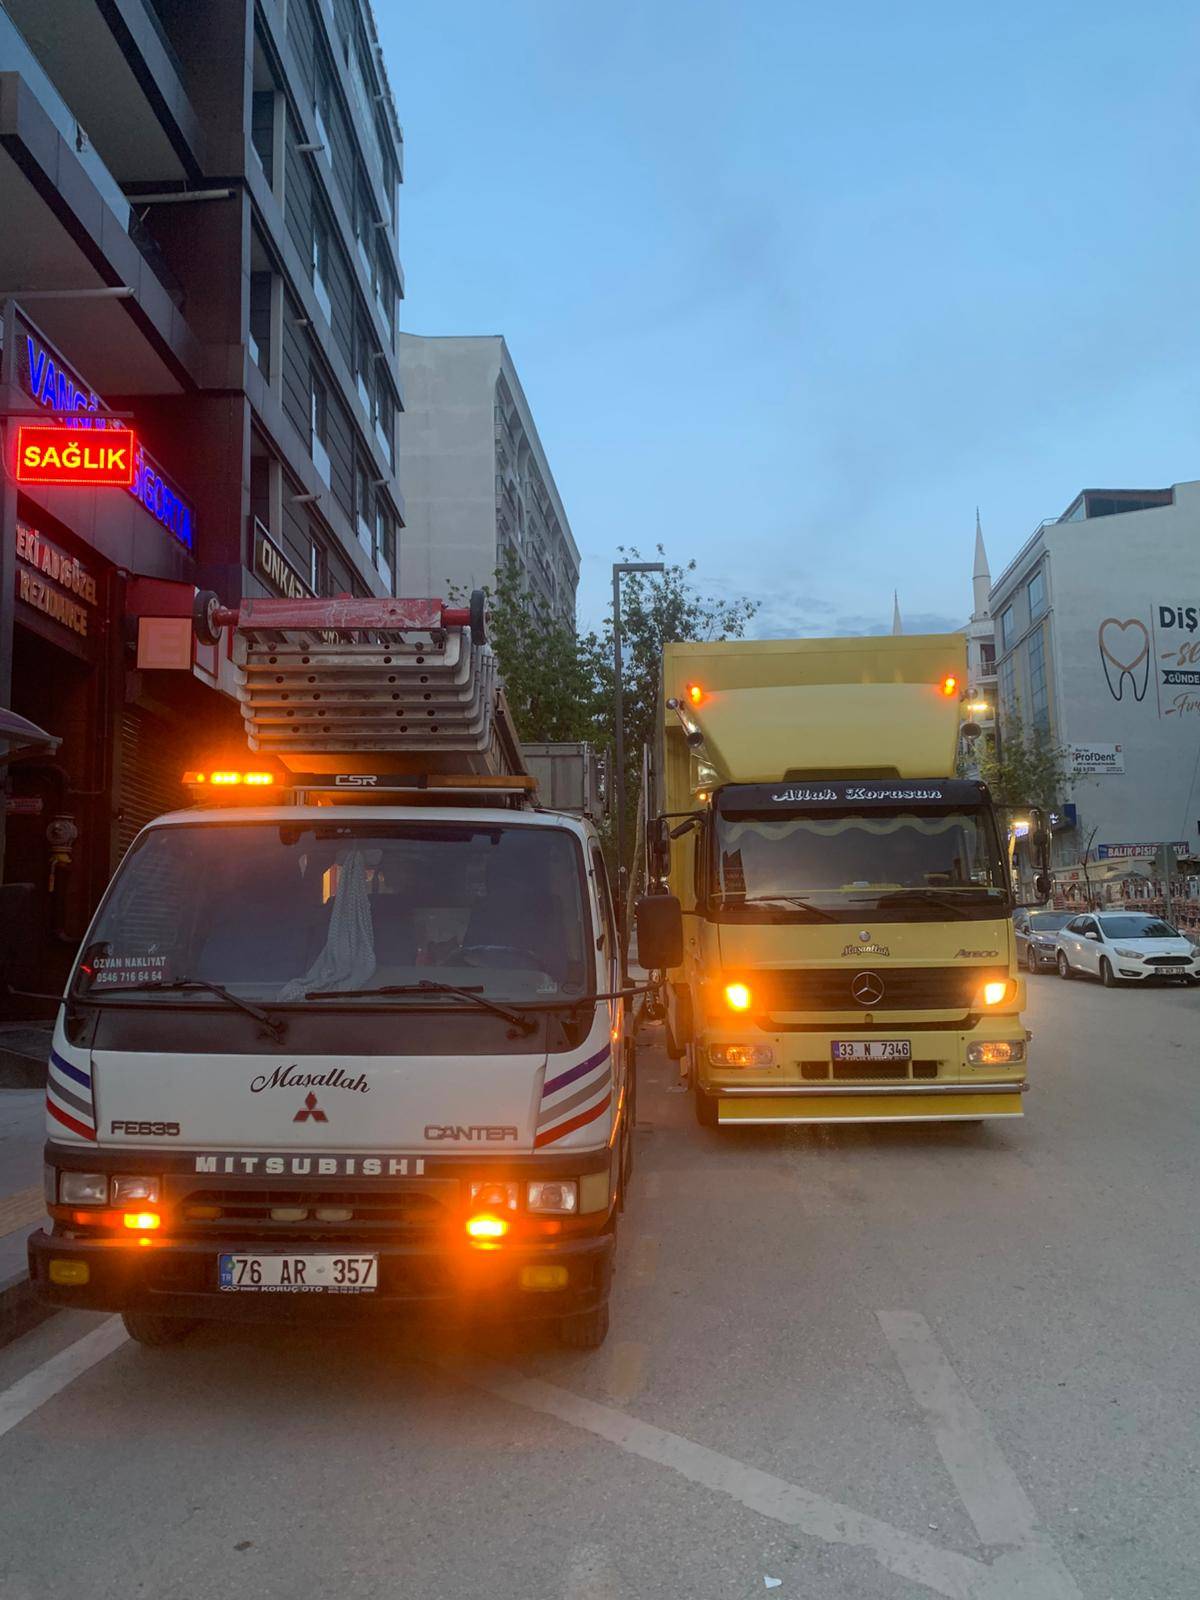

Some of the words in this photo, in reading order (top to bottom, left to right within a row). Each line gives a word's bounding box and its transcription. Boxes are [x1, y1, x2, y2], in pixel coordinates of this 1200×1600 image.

[24, 442, 126, 470] SAĞLIK
[336, 774, 377, 785] CSR
[772, 789, 837, 801] Allah
[840, 1044, 854, 1056] 33
[864, 1043, 871, 1056] N
[881, 1043, 909, 1055] 7346
[424, 1126, 518, 1141] CANTER
[196, 1156, 424, 1175] MITSUBISHI
[236, 1259, 262, 1284] 76
[280, 1259, 306, 1284] AR
[333, 1259, 374, 1284] 357
